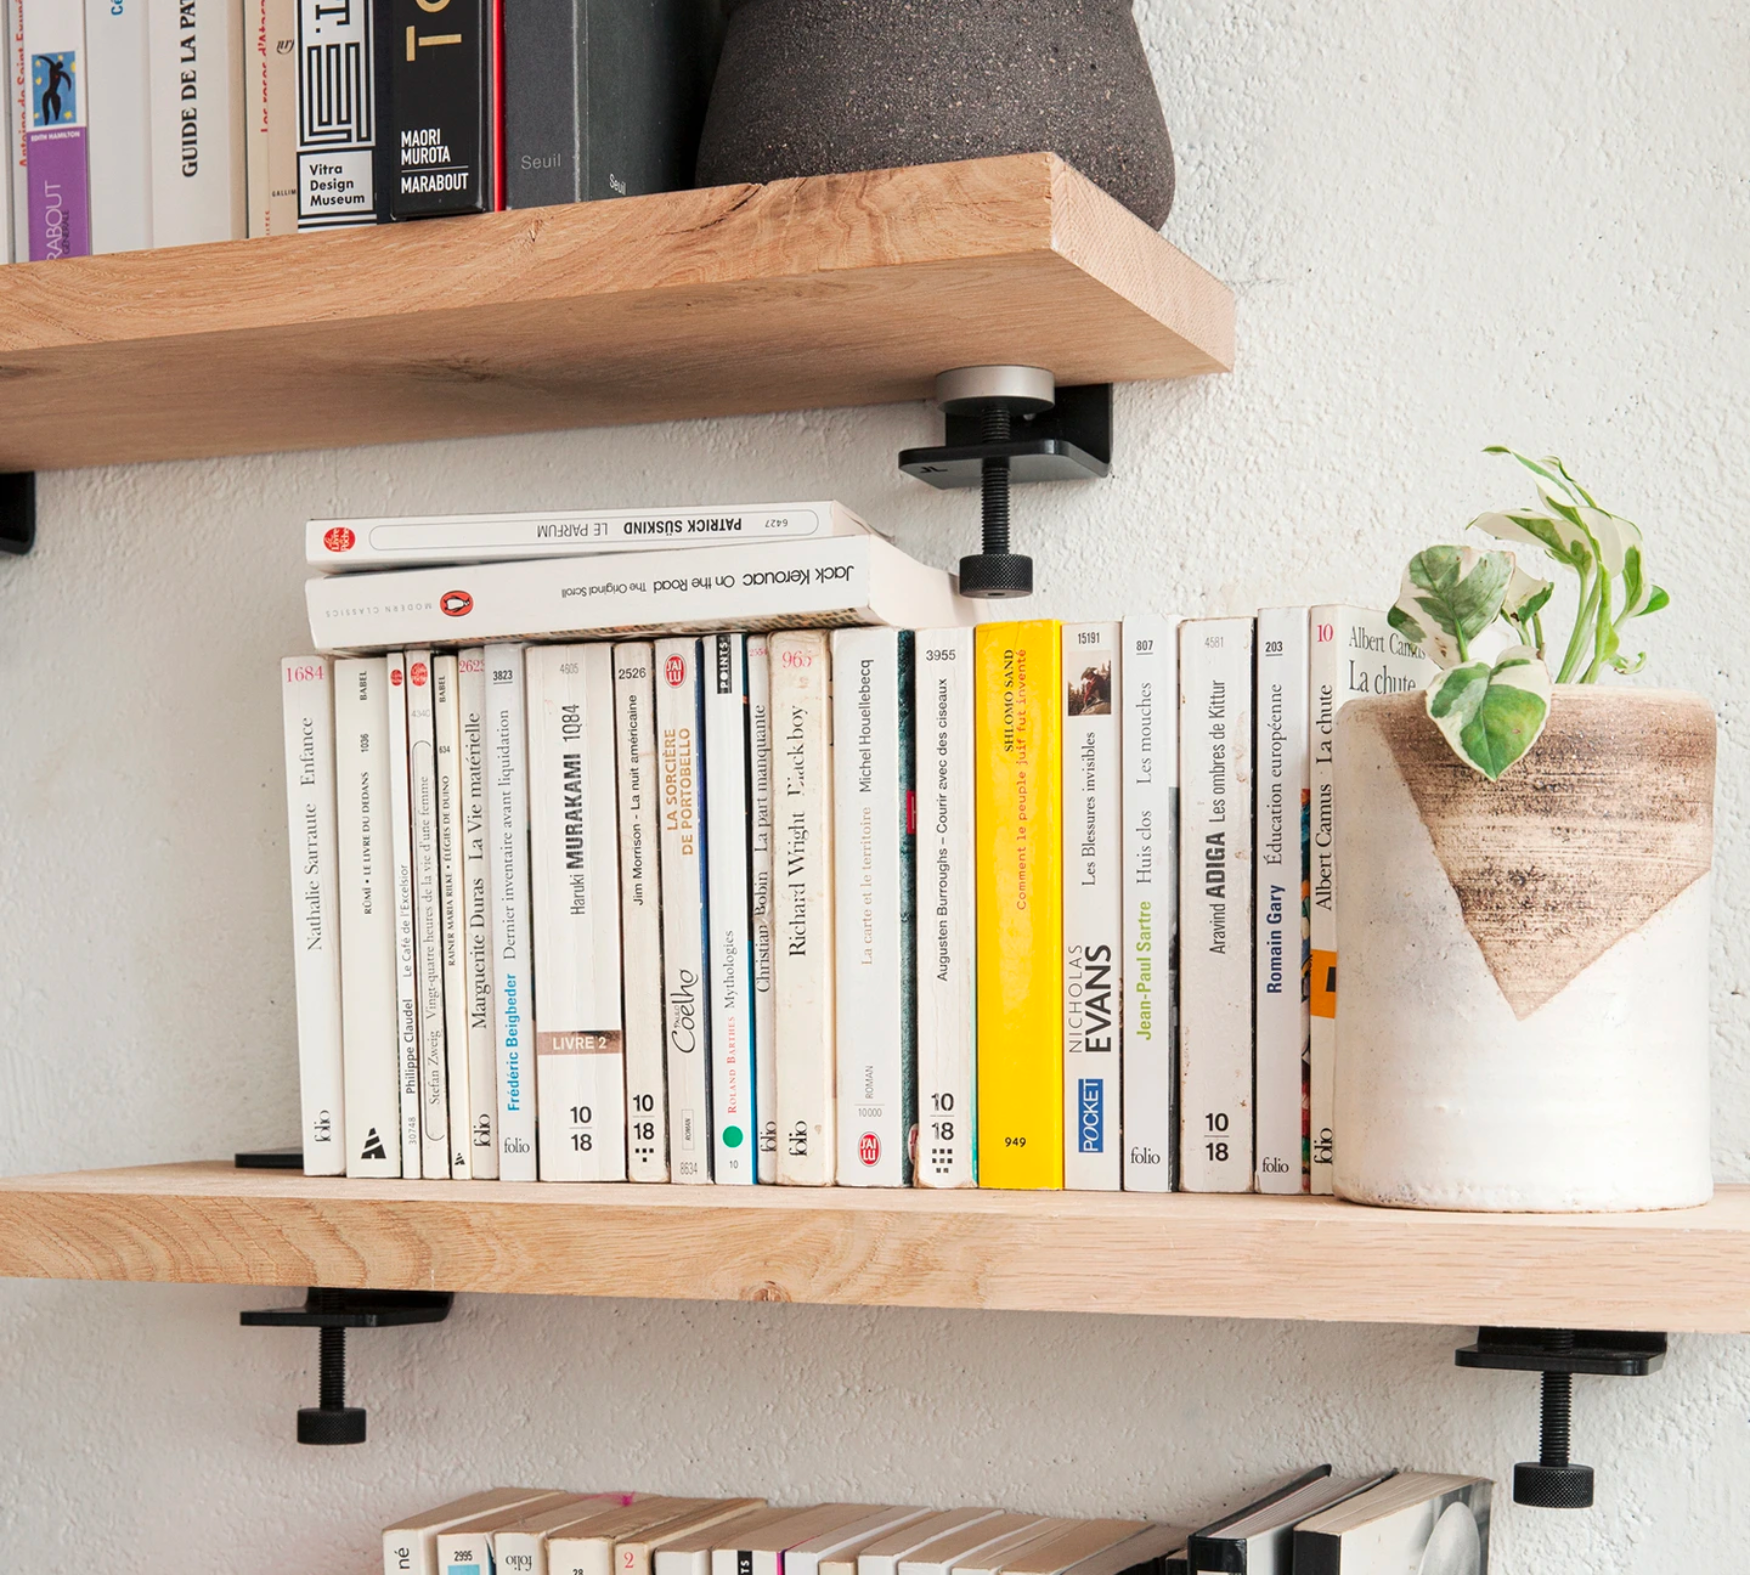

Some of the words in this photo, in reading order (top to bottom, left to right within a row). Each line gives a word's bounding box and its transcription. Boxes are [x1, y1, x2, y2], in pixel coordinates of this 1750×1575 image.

[180, 35, 196, 64] LA
[180, 69, 197, 100] DE
[31, 134, 48, 142] EDITH
[48, 130, 80, 140] HAMILTON
[182, 107, 198, 178] GUIDE
[401, 128, 441, 148] MAORI
[309, 163, 343, 176] Vitra
[401, 146, 451, 166] MUROTA
[520, 152, 561, 171] Seuil
[310, 178, 354, 195] Design
[401, 173, 468, 194] MARABOUT
[609, 174, 626, 196] Seuil
[310, 192, 365, 207] Museum
[537, 523, 588, 538] PARFUM
[624, 520, 683, 535] SÜSKIND
[687, 518, 742, 533] PATRICK
[654, 578, 688, 594] Road
[692, 577, 712, 591] the
[716, 574, 735, 588] On
[742, 568, 810, 588] Kerouac
[814, 564, 854, 583] Jack
[561, 586, 587, 598] Scroll
[588, 583, 628, 597] Original
[384, 602, 432, 613] MODERN
[1078, 632, 1100, 644] 15191
[1136, 640, 1154, 651] 807
[1266, 641, 1283, 652] 203
[1318, 624, 1334, 642] 10
[1349, 626, 1385, 653] Albert
[720, 641, 729, 689] POINTS
[926, 649, 956, 661] 3955
[1004, 650, 1014, 688] SAND
[287, 666, 324, 682] 1684
[360, 670, 368, 700] BABEL
[438, 675, 447, 702] BABEL
[493, 670, 514, 682] 3823
[618, 668, 646, 680] 2526
[1016, 650, 1027, 704] inventé
[1349, 660, 1370, 693] La
[858, 660, 874, 744] Houellebecq
[936, 678, 948, 728] ciseaux
[1208, 680, 1225, 719] Kittur
[1316, 684, 1334, 735] chute
[626, 694, 639, 764] américaine
[1004, 691, 1014, 752] SHLOMO
[1016, 710, 1027, 732] fut
[1136, 682, 1152, 752] mouches
[1267, 684, 1287, 778] européenne
[299, 717, 316, 786] Enfance
[361, 733, 370, 752] 1036
[465, 712, 482, 798] matérielle
[497, 710, 514, 786] liquidation
[754, 705, 771, 792] manquante
[1316, 742, 1334, 764] La
[662, 728, 678, 806] SORCIÈRE
[858, 748, 872, 792] Michel
[937, 760, 948, 790] avec
[1081, 732, 1096, 792] invisibles
[1136, 755, 1152, 784] Les
[1208, 744, 1225, 795] ombres
[361, 772, 371, 814] DEDANS
[442, 775, 450, 808] DUINO
[629, 767, 640, 790] nuit
[679, 728, 693, 829] PORTOBELLO
[630, 794, 640, 810] La
[756, 796, 772, 827] part
[1016, 772, 1028, 820] peuple
[1208, 800, 1226, 822] Les
[362, 816, 371, 832] DU
[467, 804, 484, 833] Vie
[562, 754, 584, 870] MURAKAMI
[666, 810, 678, 831] LA
[936, 794, 948, 834] Courir
[1082, 796, 1096, 858] Blessures
[1136, 810, 1152, 840] clos
[1264, 783, 1283, 866] Éducation
[1316, 784, 1333, 848] Camus
[304, 803, 320, 874] Sarraute
[362, 834, 372, 862] LIVRE
[420, 820, 431, 852] d'une
[442, 826, 452, 862] ÉLÉGIES
[682, 834, 694, 856] DE
[787, 811, 809, 876] Wright
[860, 806, 872, 870] territoire
[1016, 826, 1027, 841] le
[468, 838, 484, 861] La
[632, 823, 644, 880] Morrison
[1136, 846, 1152, 884] Huis
[501, 833, 514, 901] inventaire
[1016, 846, 1028, 910] Comment
[1082, 862, 1096, 886] Les
[1205, 832, 1226, 899] ADIGA
[422, 888, 432, 903] de
[445, 873, 454, 897] RILKE
[570, 874, 586, 915] Haruki
[754, 871, 768, 916] Bobin
[936, 848, 950, 916] Burroughs
[1316, 852, 1334, 911] Albert
[470, 878, 486, 928] Duras
[861, 892, 872, 905] et
[1266, 885, 1286, 925] Gary
[304, 880, 322, 950] Nathalie
[401, 919, 411, 933] de
[446, 900, 455, 930] MARIA
[787, 883, 807, 957] Richard
[862, 910, 873, 944] carte
[1136, 902, 1152, 952] Sartre
[1208, 904, 1226, 954] Aravind
[502, 906, 516, 960] Dernier
[400, 936, 412, 963] Café
[447, 932, 456, 966] RAINER
[755, 926, 771, 993] Christian
[861, 948, 872, 966] La
[937, 920, 951, 982] Augusten
[1266, 930, 1282, 994] Romain
[401, 966, 412, 978] Le
[424, 946, 439, 1019] Vingt-quatre
[470, 934, 491, 1030] Marguerite
[722, 930, 738, 1009] Mythologies
[504, 974, 520, 1048] Beigbeder
[670, 969, 699, 1054] Coelho
[1068, 945, 1083, 1054] NICHOLAS
[1084, 944, 1112, 1053] EVANS
[1136, 958, 1152, 1041] Jean-Paul
[402, 998, 415, 1043] Claudel
[598, 1037, 607, 1050] 2
[404, 1046, 419, 1095] Philippe
[506, 1052, 520, 1112] Frédéric
[865, 1065, 874, 1100] ROMAN
[570, 1106, 592, 1124] 10
[632, 1094, 654, 1112] 10
[932, 1093, 954, 1112] 10
[1083, 1079, 1100, 1152] POCKET
[314, 1109, 332, 1142] folio
[408, 1116, 418, 1145] 30748
[474, 1114, 491, 1147] folio
[633, 1122, 655, 1140] 18
[760, 1121, 778, 1153] folio
[932, 1122, 954, 1141] 18
[1206, 1112, 1229, 1132] 10
[571, 1134, 593, 1152] 18
[789, 1120, 808, 1157] folio
[1005, 1136, 1026, 1148] 949
[1206, 1142, 1230, 1162] 18
[1314, 1128, 1334, 1166] folio
[1130, 1147, 1160, 1164] folio
[1262, 1158, 1290, 1174] folio
[454, 1550, 473, 1562] 2995
[506, 1555, 532, 1571] folio
[624, 1552, 634, 1568] 2
